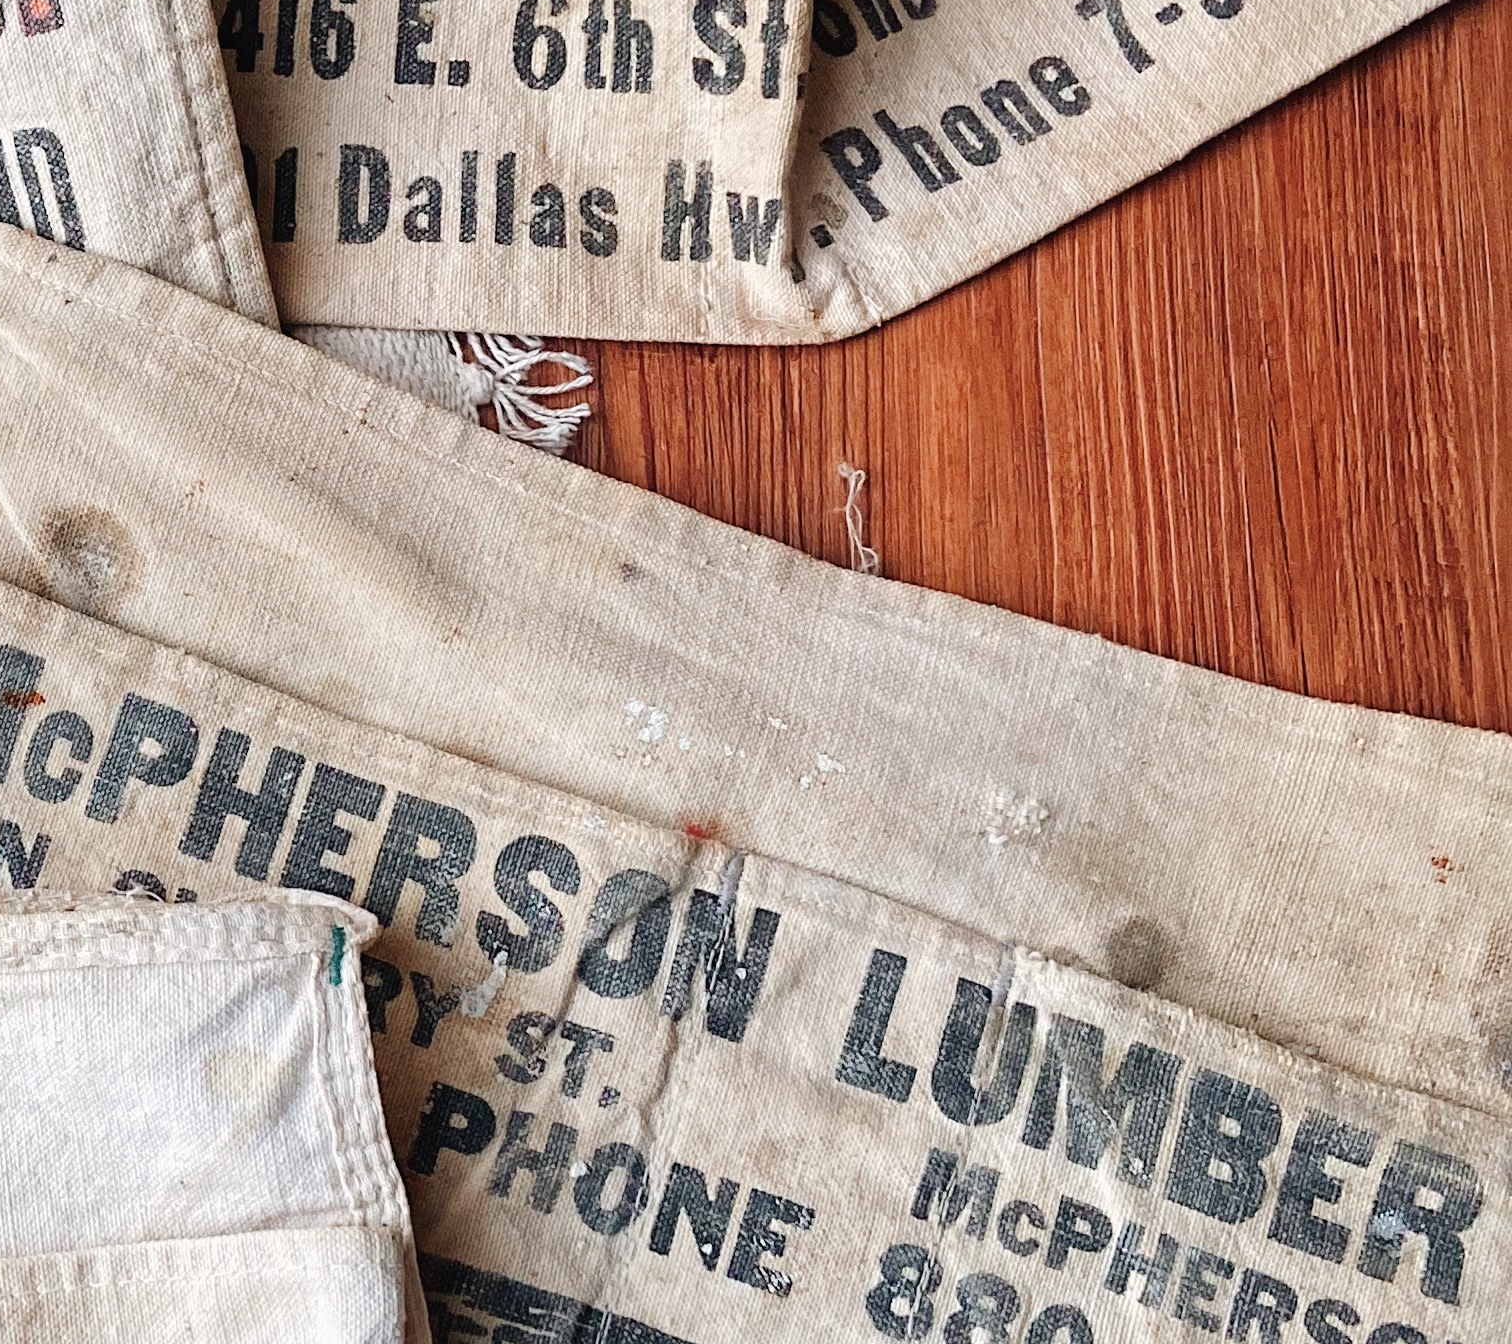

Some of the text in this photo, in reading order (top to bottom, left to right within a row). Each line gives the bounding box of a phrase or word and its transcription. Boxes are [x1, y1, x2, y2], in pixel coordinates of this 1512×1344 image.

[337, 142, 619, 258] Dallas
[819, 55, 1092, 223] Phone
[494, 1009, 621, 1110] ST.
[835, 947, 1485, 1308] LUMBER
[408, 1081, 816, 1297] PHONE
